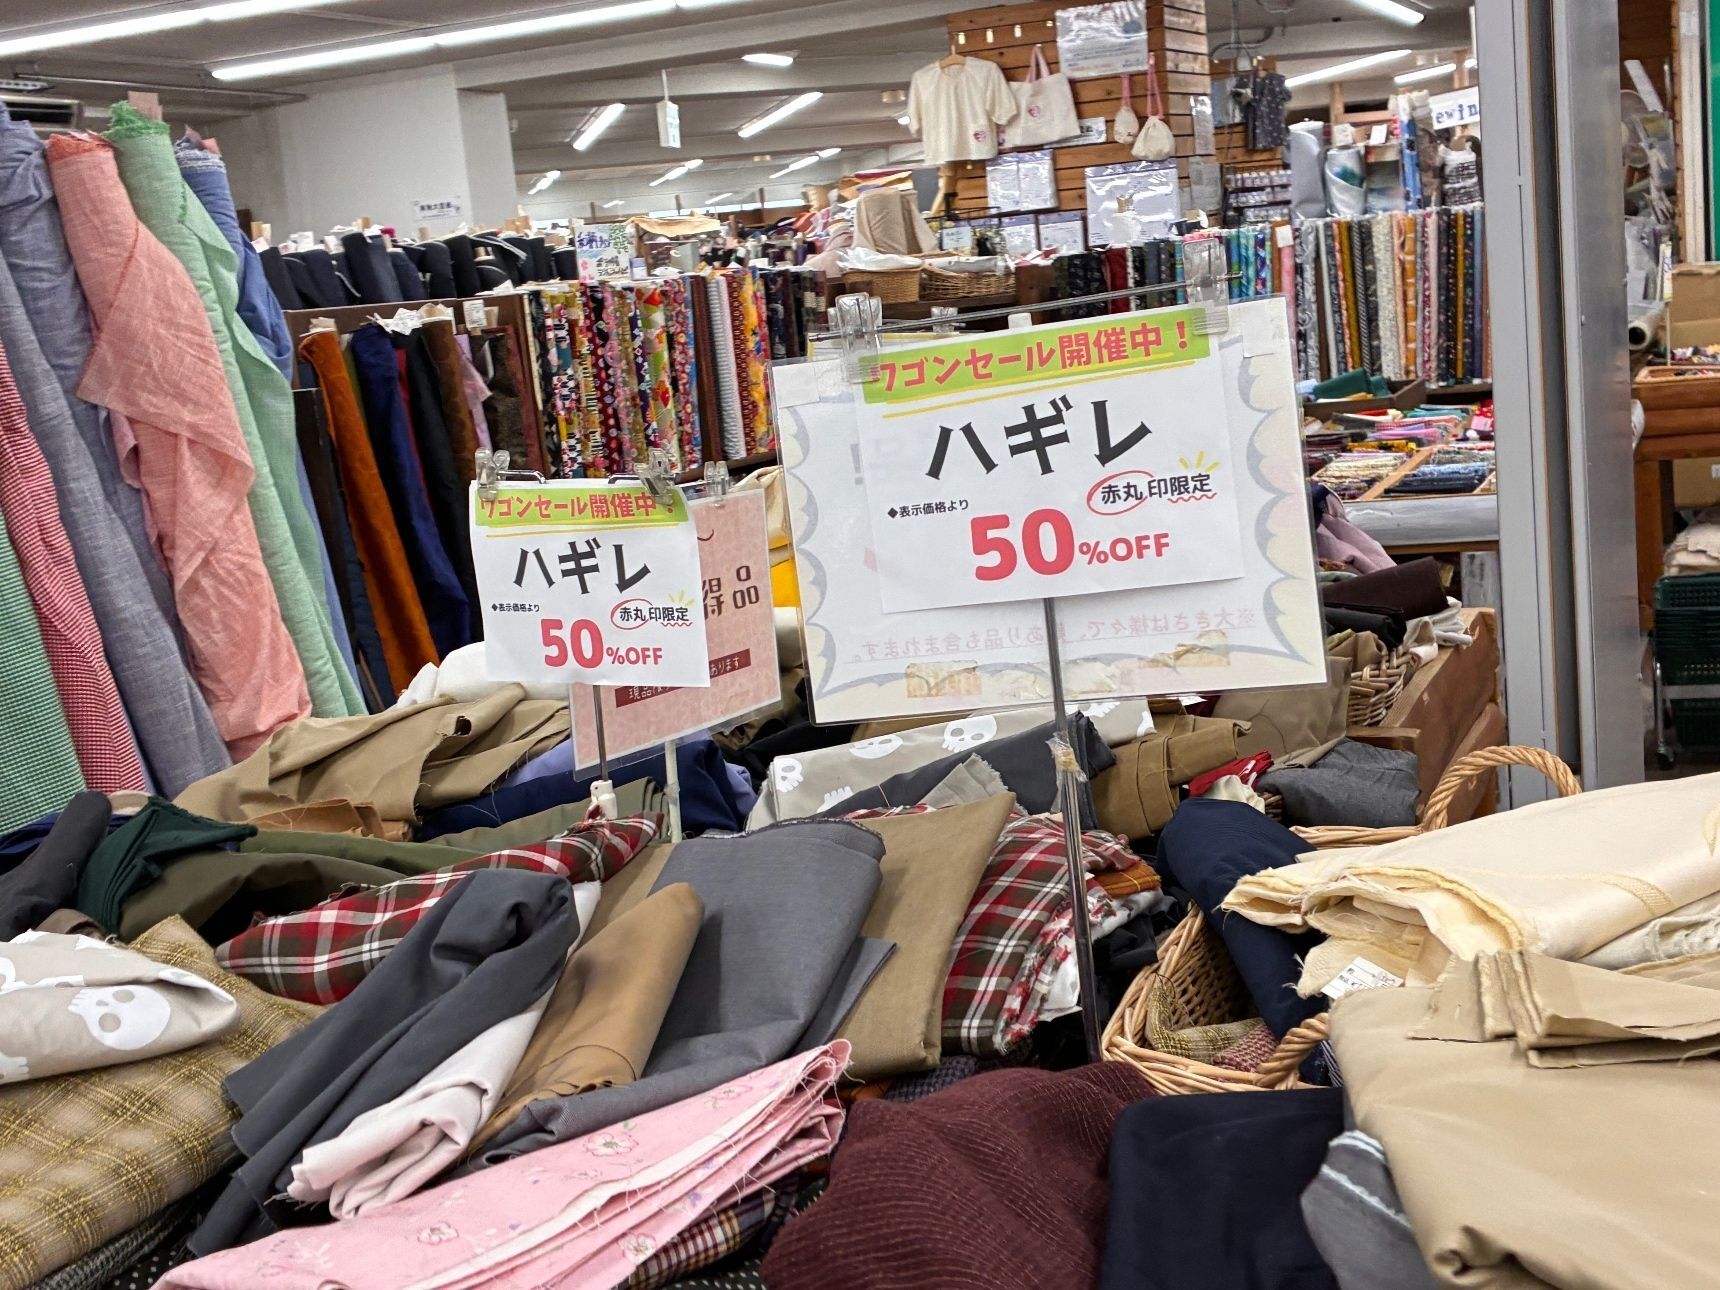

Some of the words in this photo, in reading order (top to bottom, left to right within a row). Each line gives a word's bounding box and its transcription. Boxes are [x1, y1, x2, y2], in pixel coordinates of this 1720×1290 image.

[869, 320, 1189, 392] ワゴンセール開催中！
[924, 393, 1153, 481] ハギレ
[1100, 472, 1213, 505] 赤丸印限定
[480, 491, 675, 519] ワゴンセール開催中
[898, 498, 970, 518] 表示価格より
[512, 536, 652, 596] ハギレ
[498, 602, 541, 613] 表示価格より
[619, 606, 690, 622] 赤丸印限定
